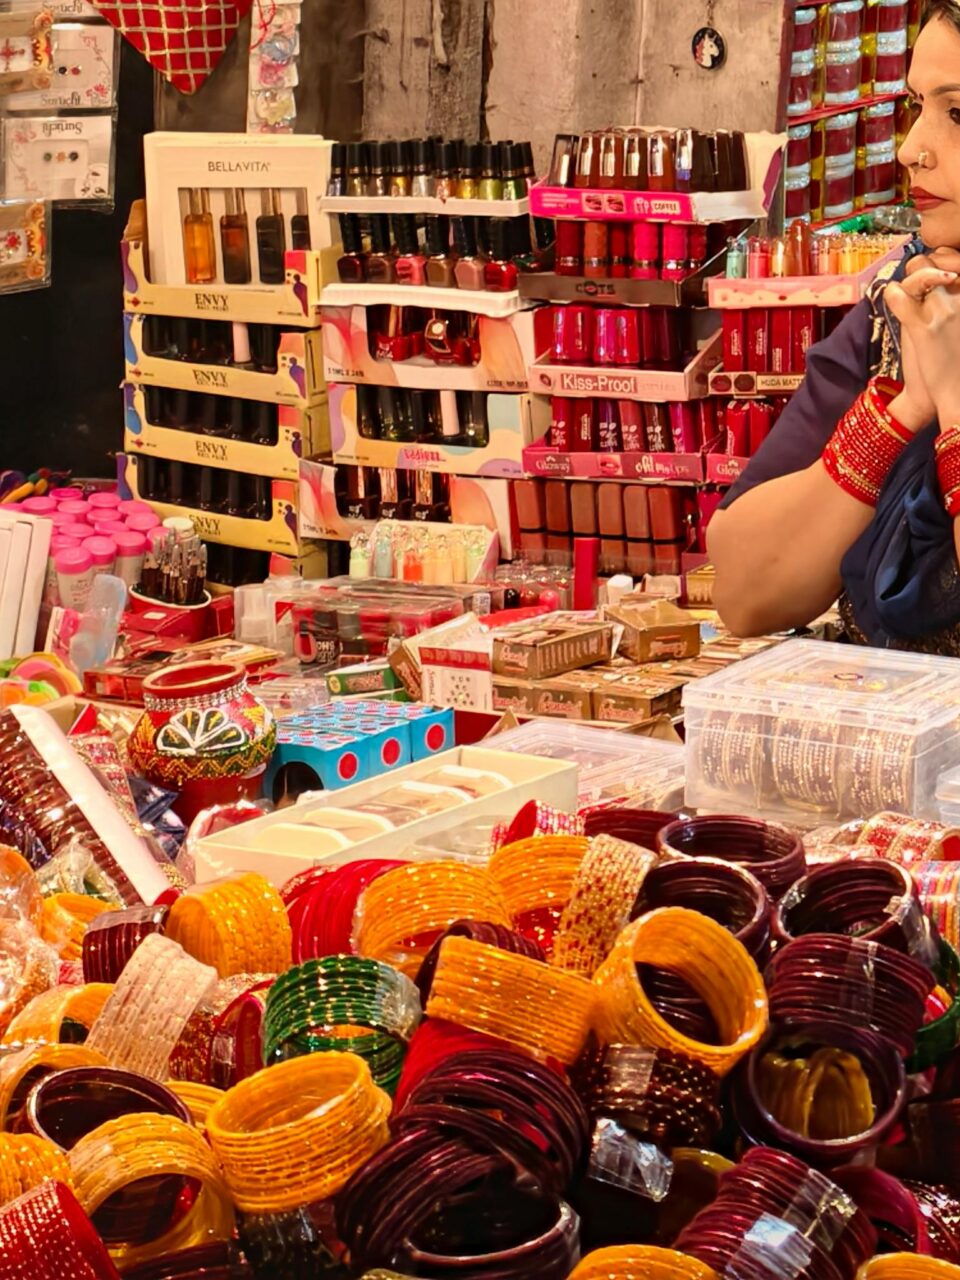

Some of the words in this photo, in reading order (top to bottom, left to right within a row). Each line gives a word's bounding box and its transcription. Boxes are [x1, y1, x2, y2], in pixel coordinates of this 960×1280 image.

[195, 293, 229, 307] ENVY
[192, 369, 229, 385] ENVY
[562, 373, 636, 394] Kiss-Proof
[195, 440, 229, 457] ENVY
